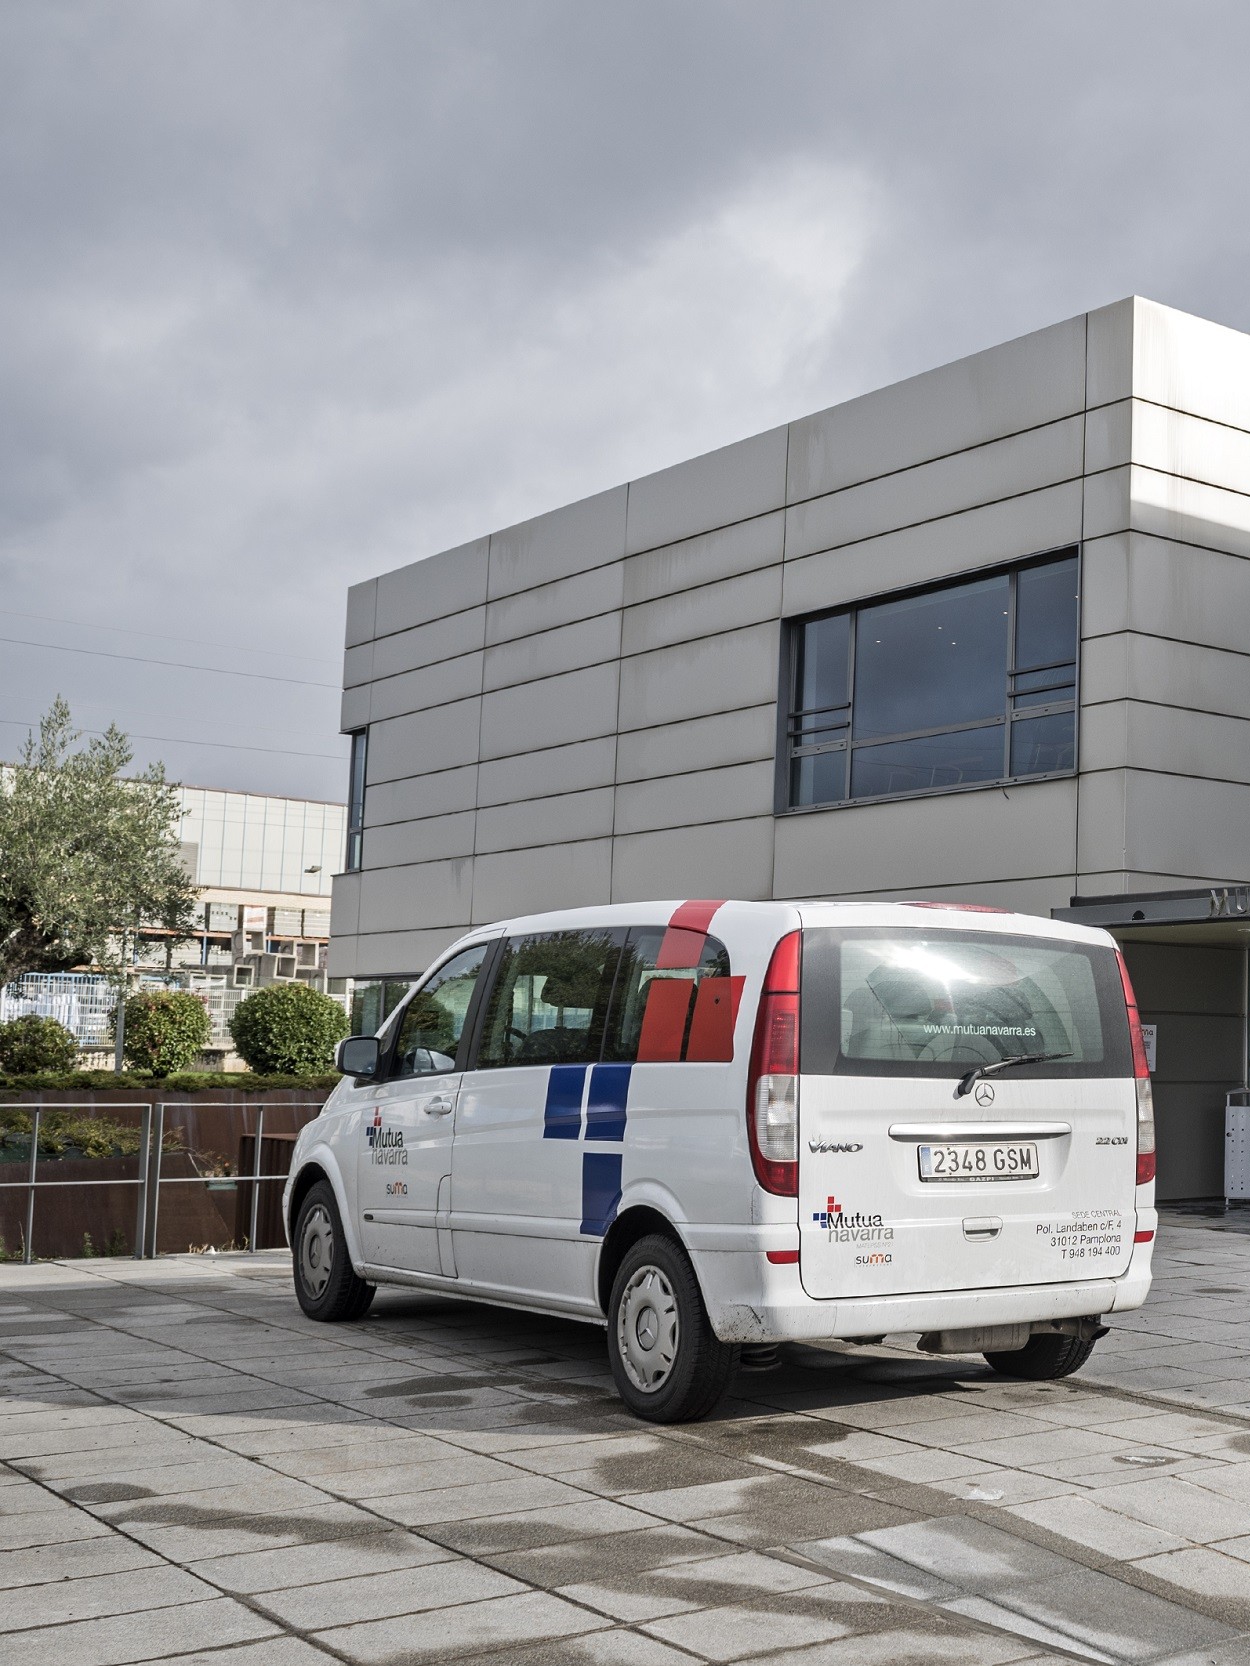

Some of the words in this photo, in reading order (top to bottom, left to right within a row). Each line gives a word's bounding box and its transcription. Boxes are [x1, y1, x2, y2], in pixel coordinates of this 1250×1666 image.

[923, 1024, 1037, 1036] www.mutuanavarra.es
[372, 1127, 404, 1148] Mutua
[808, 1141, 863, 1153] VIANO
[372, 1148, 408, 1165] navarra
[933, 1149, 986, 1173] 2348
[993, 1148, 1032, 1171] GSM
[827, 1212, 884, 1229] Mutua
[1072, 1211, 1090, 1219] SEDE
[1090, 1209, 1122, 1218] CENTRAL
[1036, 1224, 1053, 1234] Pol.
[1056, 1221, 1098, 1233] Landaben
[1116, 1220, 1122, 1228] 4
[828, 1227, 894, 1243] navarra
[1050, 1235, 1078, 1247] 31012
[1080, 1233, 1121, 1245] Pamplona
[855, 1253, 892, 1264] suma
[1061, 1249, 1067, 1259] T
[1069, 1248, 1085, 1258] 948
[1088, 1246, 1103, 1257] 194
[1104, 1245, 1121, 1256] 400
